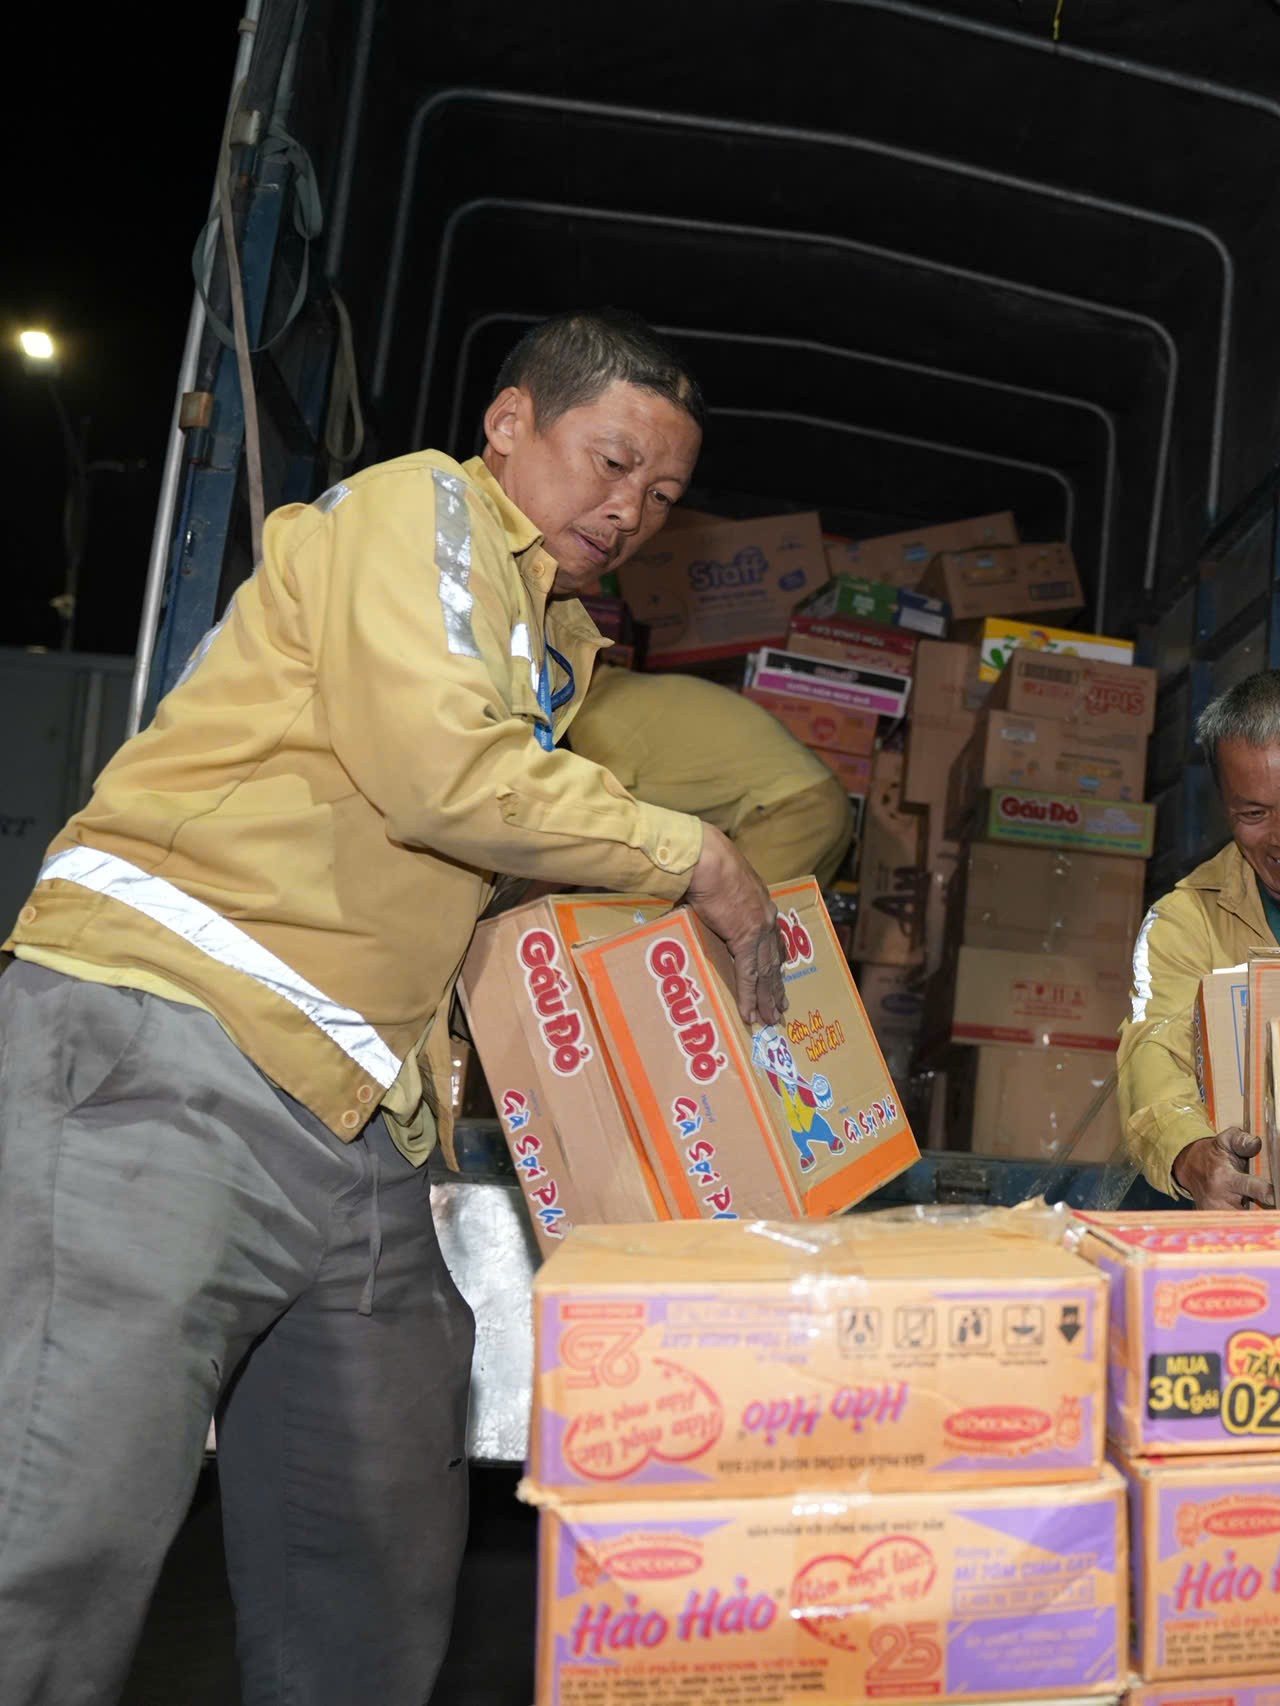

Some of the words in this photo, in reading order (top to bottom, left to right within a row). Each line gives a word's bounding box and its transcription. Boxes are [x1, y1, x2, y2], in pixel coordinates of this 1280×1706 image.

[1166, 1355, 1209, 1375] MUA
[831, 1380, 909, 1433] Hảo
[1149, 1375, 1197, 1412] 30
[1174, 1550, 1263, 1612] Hảo
[571, 1592, 669, 1655] Hảo
[677, 1574, 777, 1642] Hảo
[866, 1621, 943, 1680] 25
